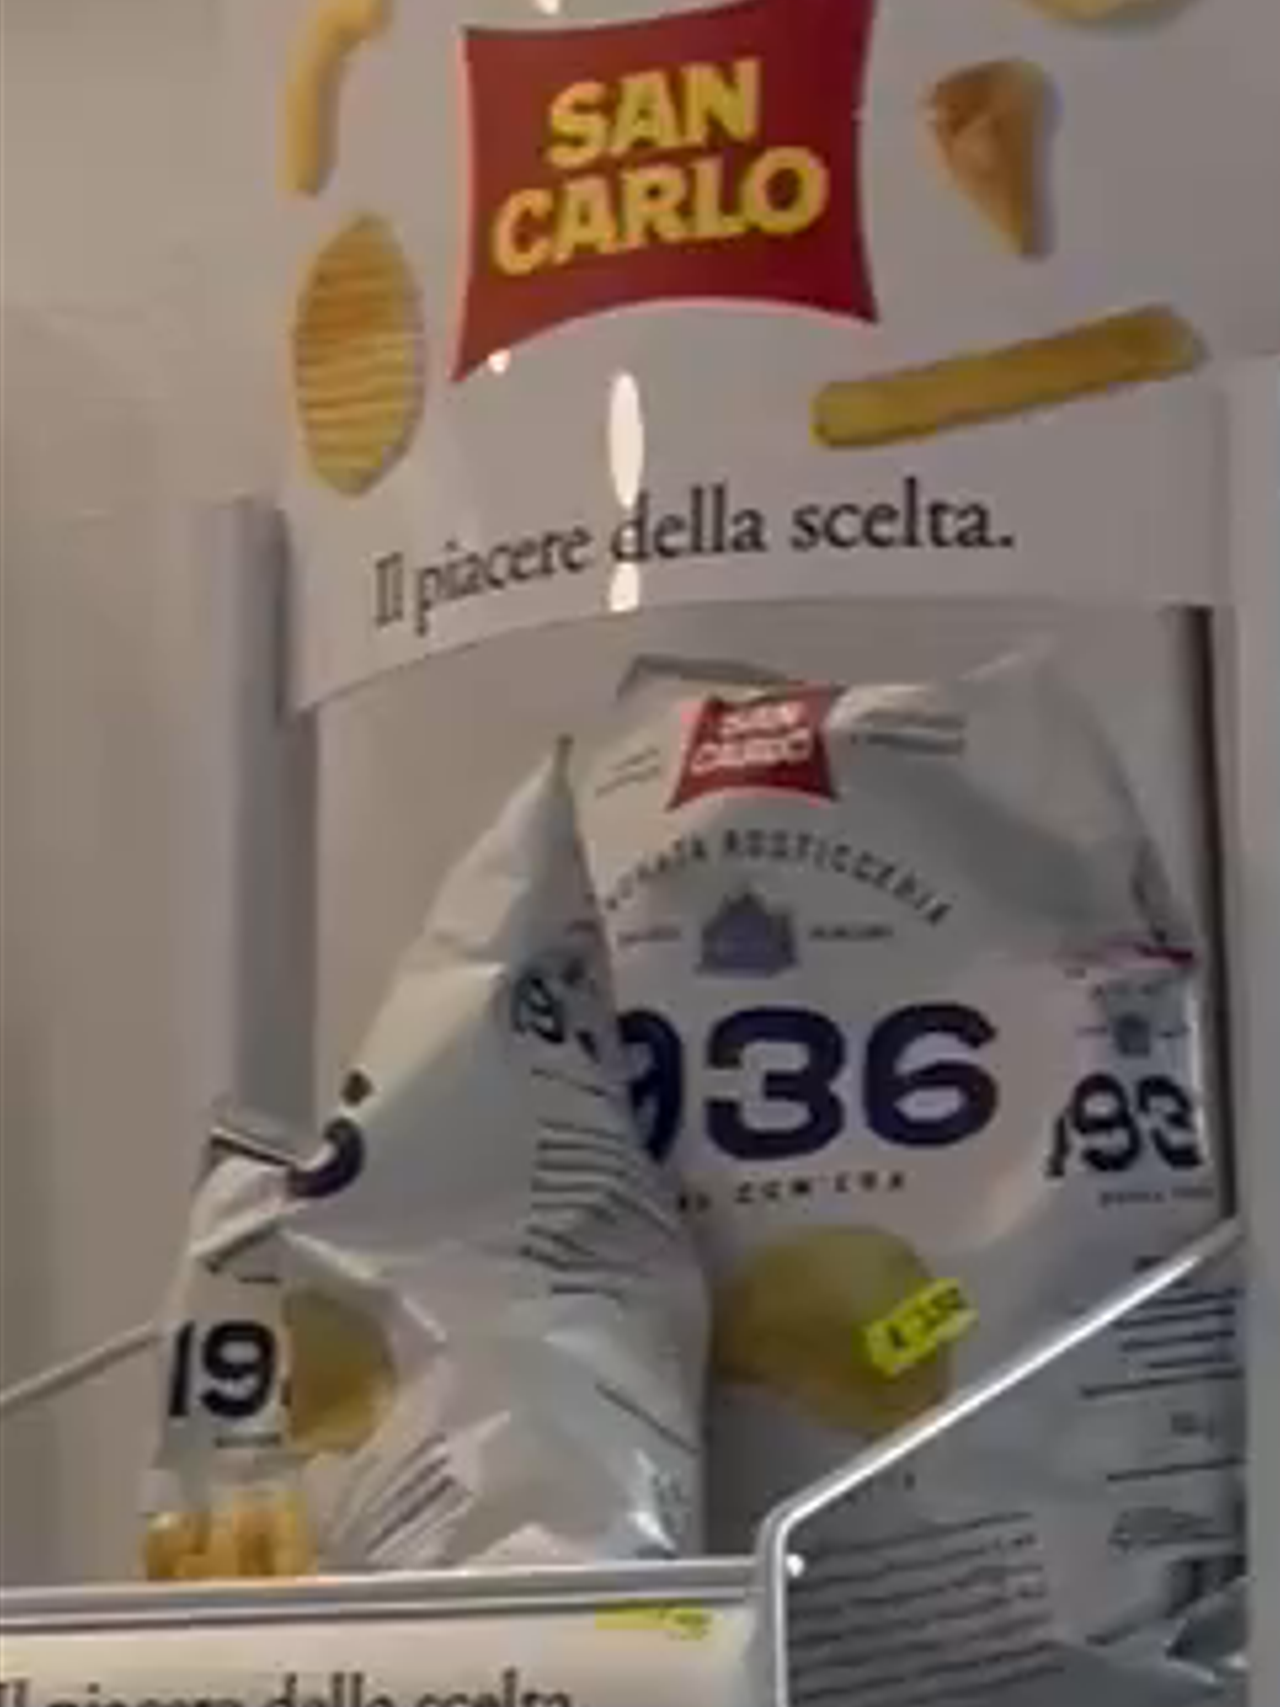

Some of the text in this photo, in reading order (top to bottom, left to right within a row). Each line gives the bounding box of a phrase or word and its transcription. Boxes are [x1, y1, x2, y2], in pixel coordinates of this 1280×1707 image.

[547, 59, 760, 170] SAN
[490, 146, 827, 277] CARLO
[374, 476, 1016, 632] Il piacere della scelta.
